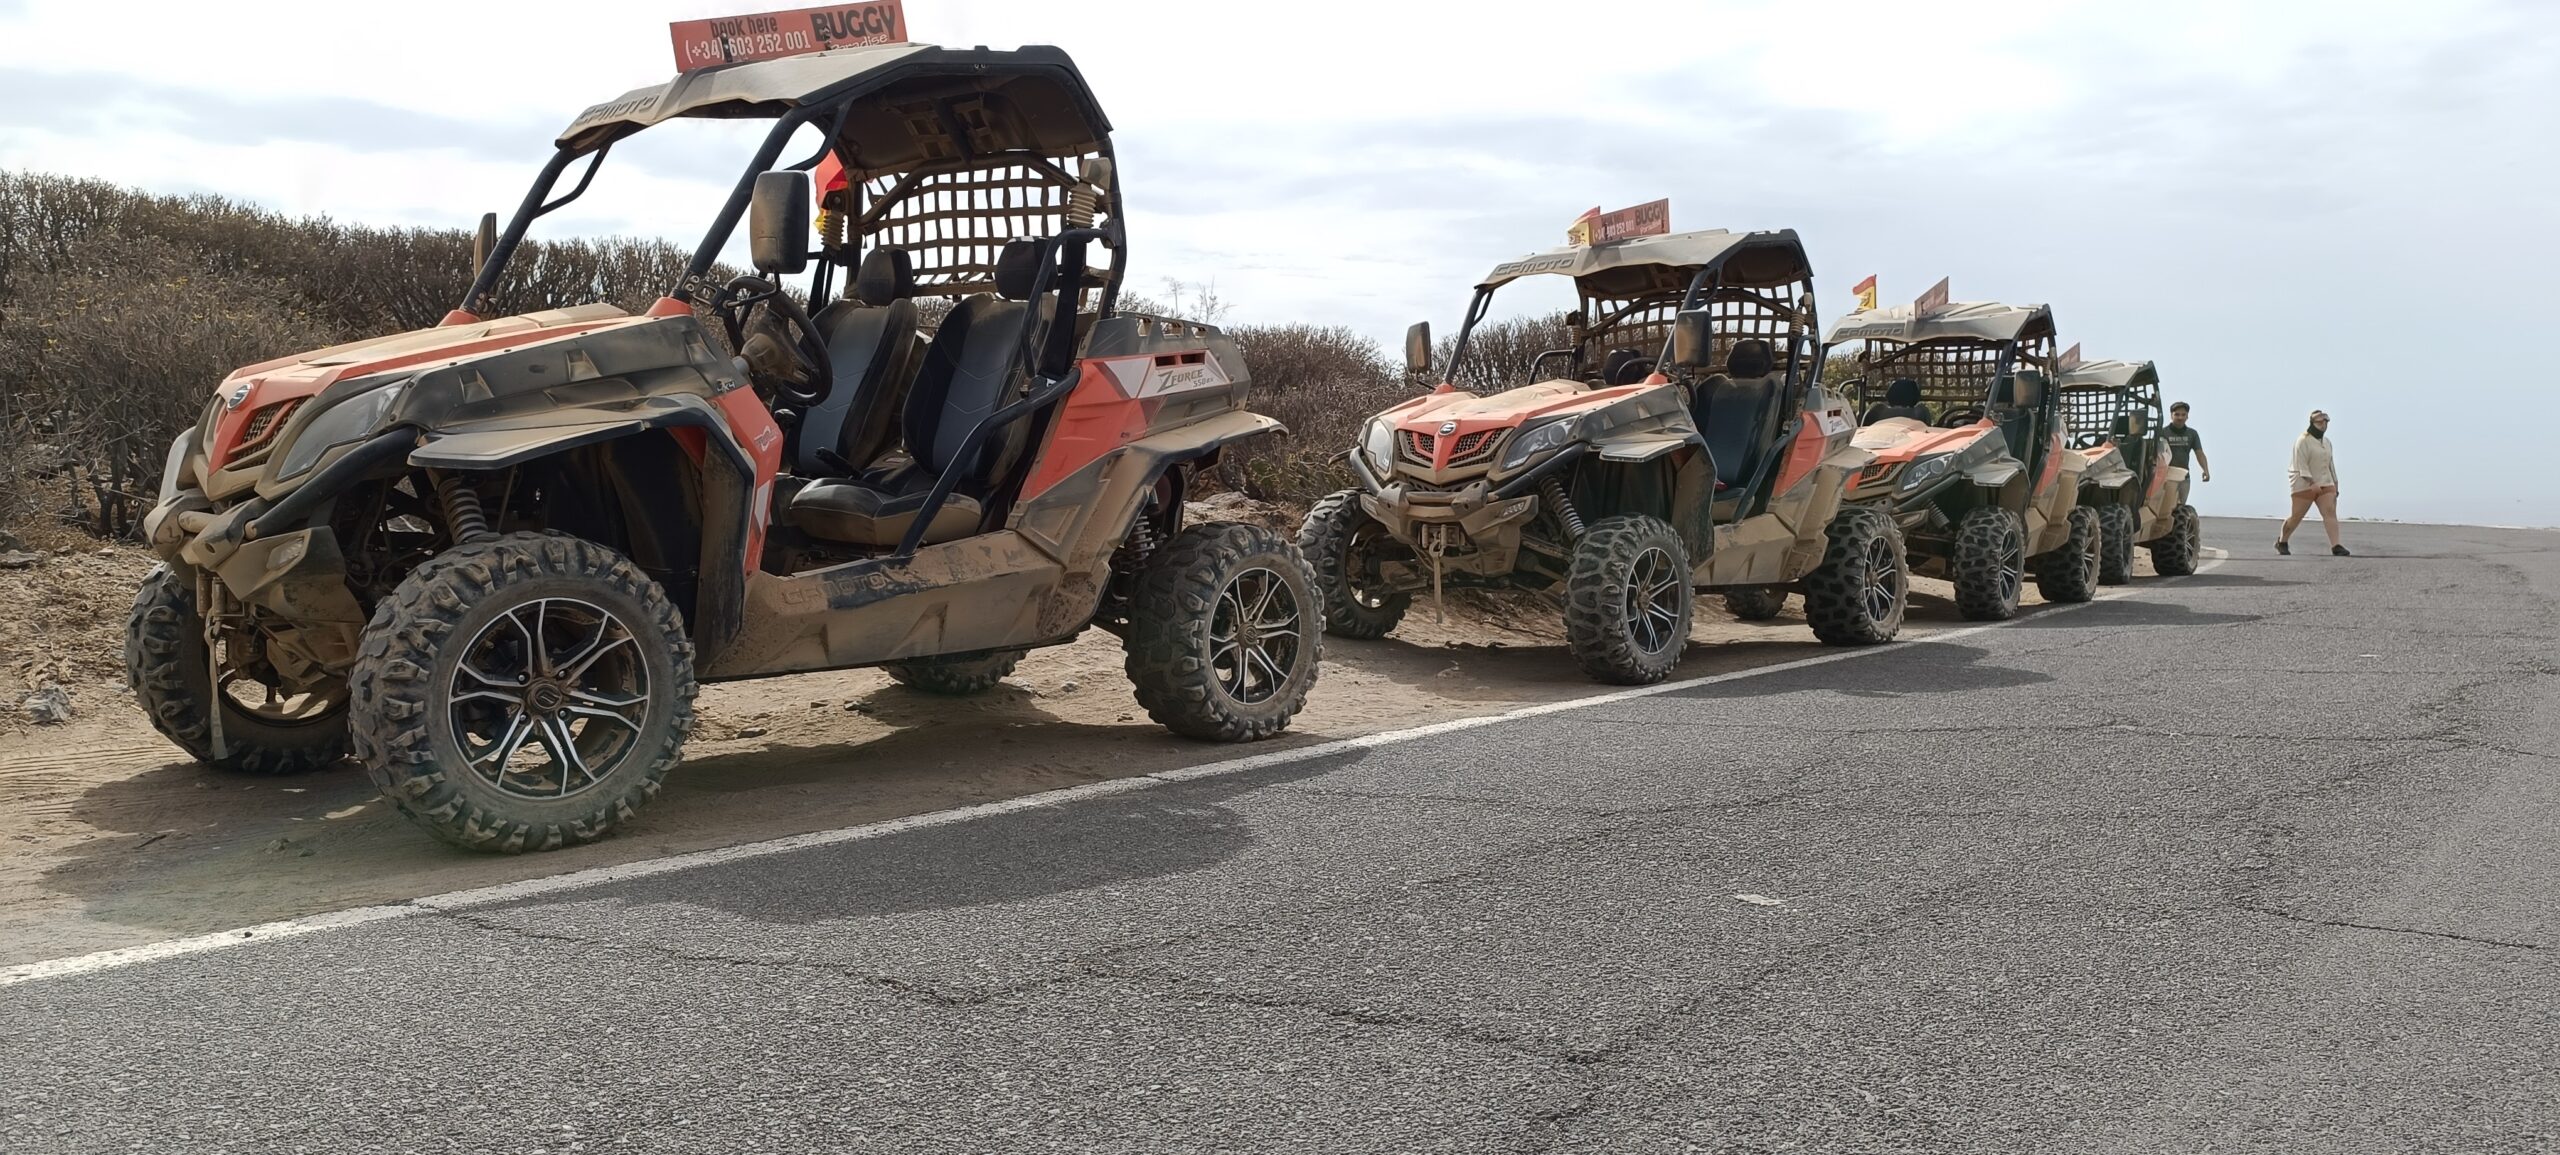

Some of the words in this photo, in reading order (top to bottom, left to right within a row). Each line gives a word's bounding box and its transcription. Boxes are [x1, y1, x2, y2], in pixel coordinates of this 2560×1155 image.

[710, 19, 746, 38] book
[747, 16, 778, 35] here
[810, 5, 895, 41] BUGGY
[728, 35, 754, 57] 603
[757, 33, 783, 54] 252
[785, 30, 811, 50] 001
[1635, 201, 1666, 226] BUGGY
[1495, 258, 1575, 276] CFMOTO
